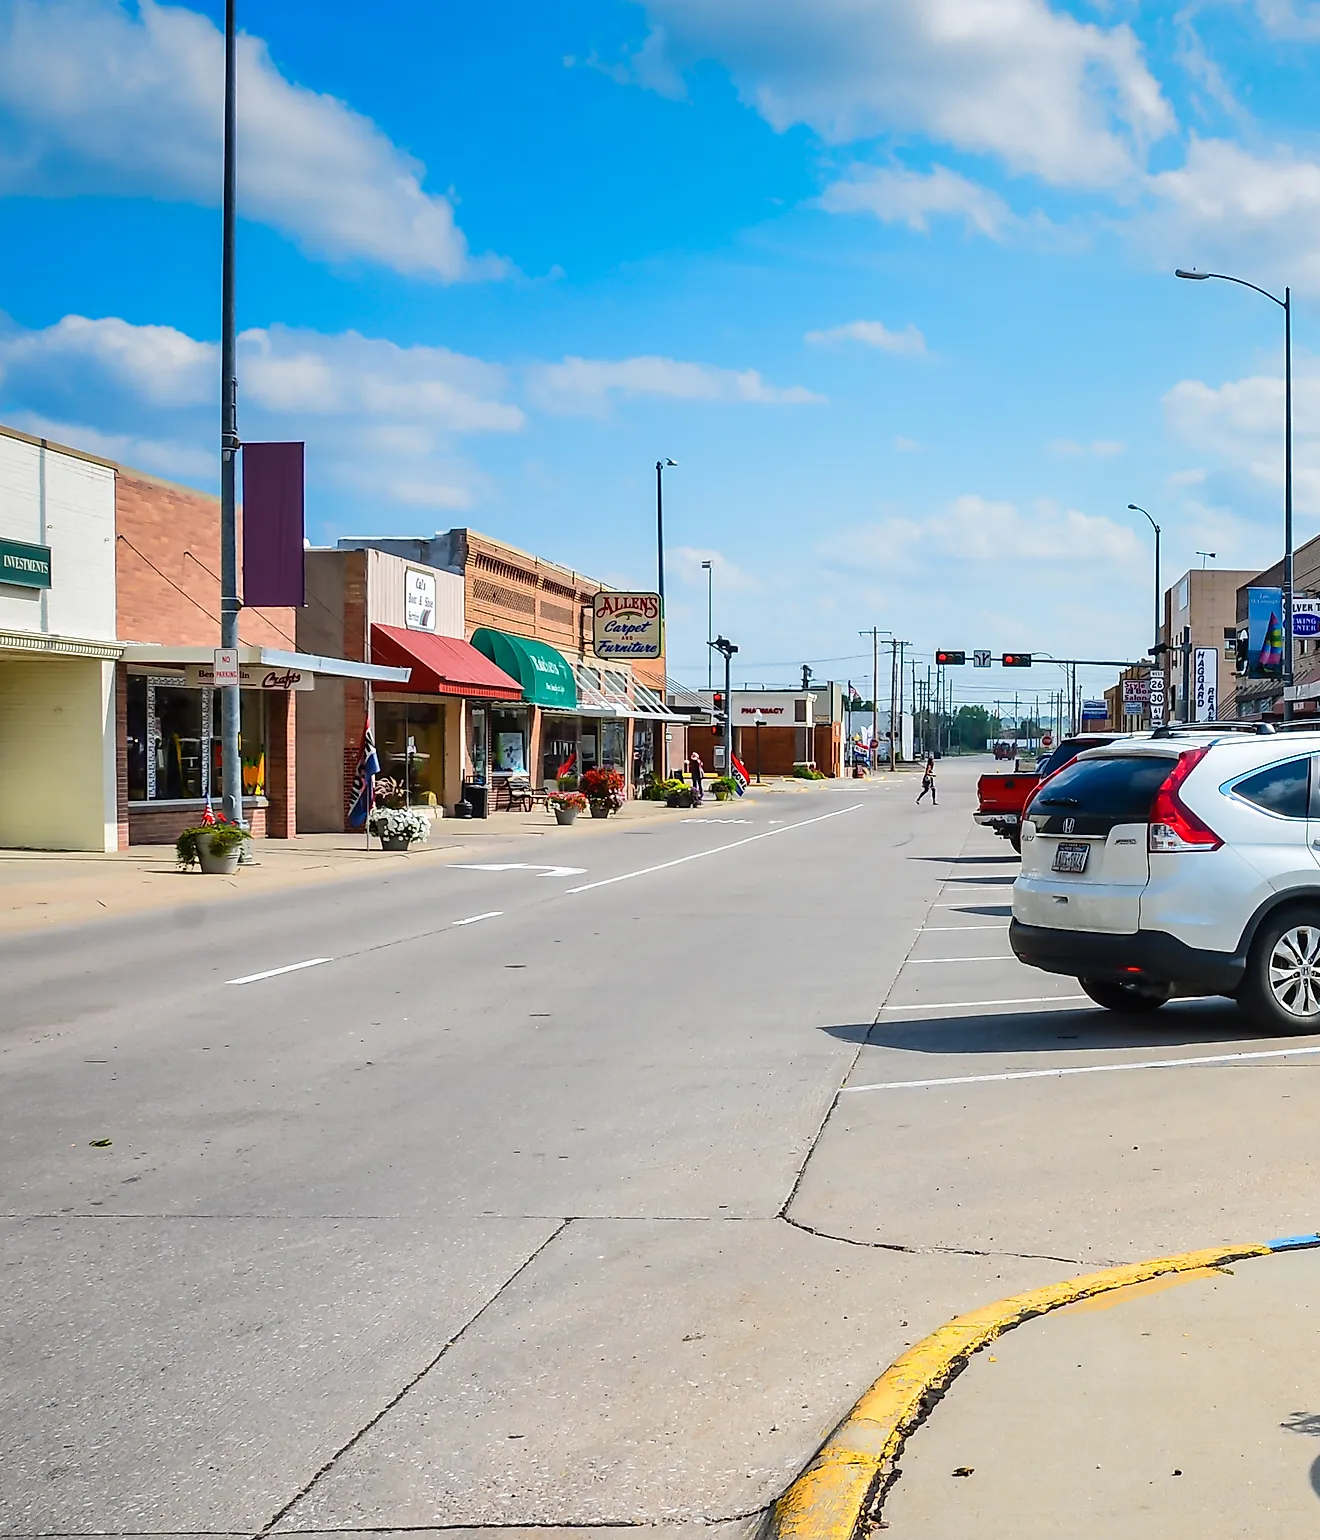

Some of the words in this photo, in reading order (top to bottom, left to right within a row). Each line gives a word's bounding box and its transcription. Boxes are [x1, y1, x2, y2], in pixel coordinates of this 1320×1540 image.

[3, 554, 49, 574] INVESTMENTS
[604, 620, 652, 636] Carpet
[597, 640, 658, 652] Furniture
[262, 669, 301, 688] Crafts
[1151, 680, 1163, 689] 26
[1197, 651, 1205, 707] HAGGARD
[1151, 694, 1163, 702] 30
